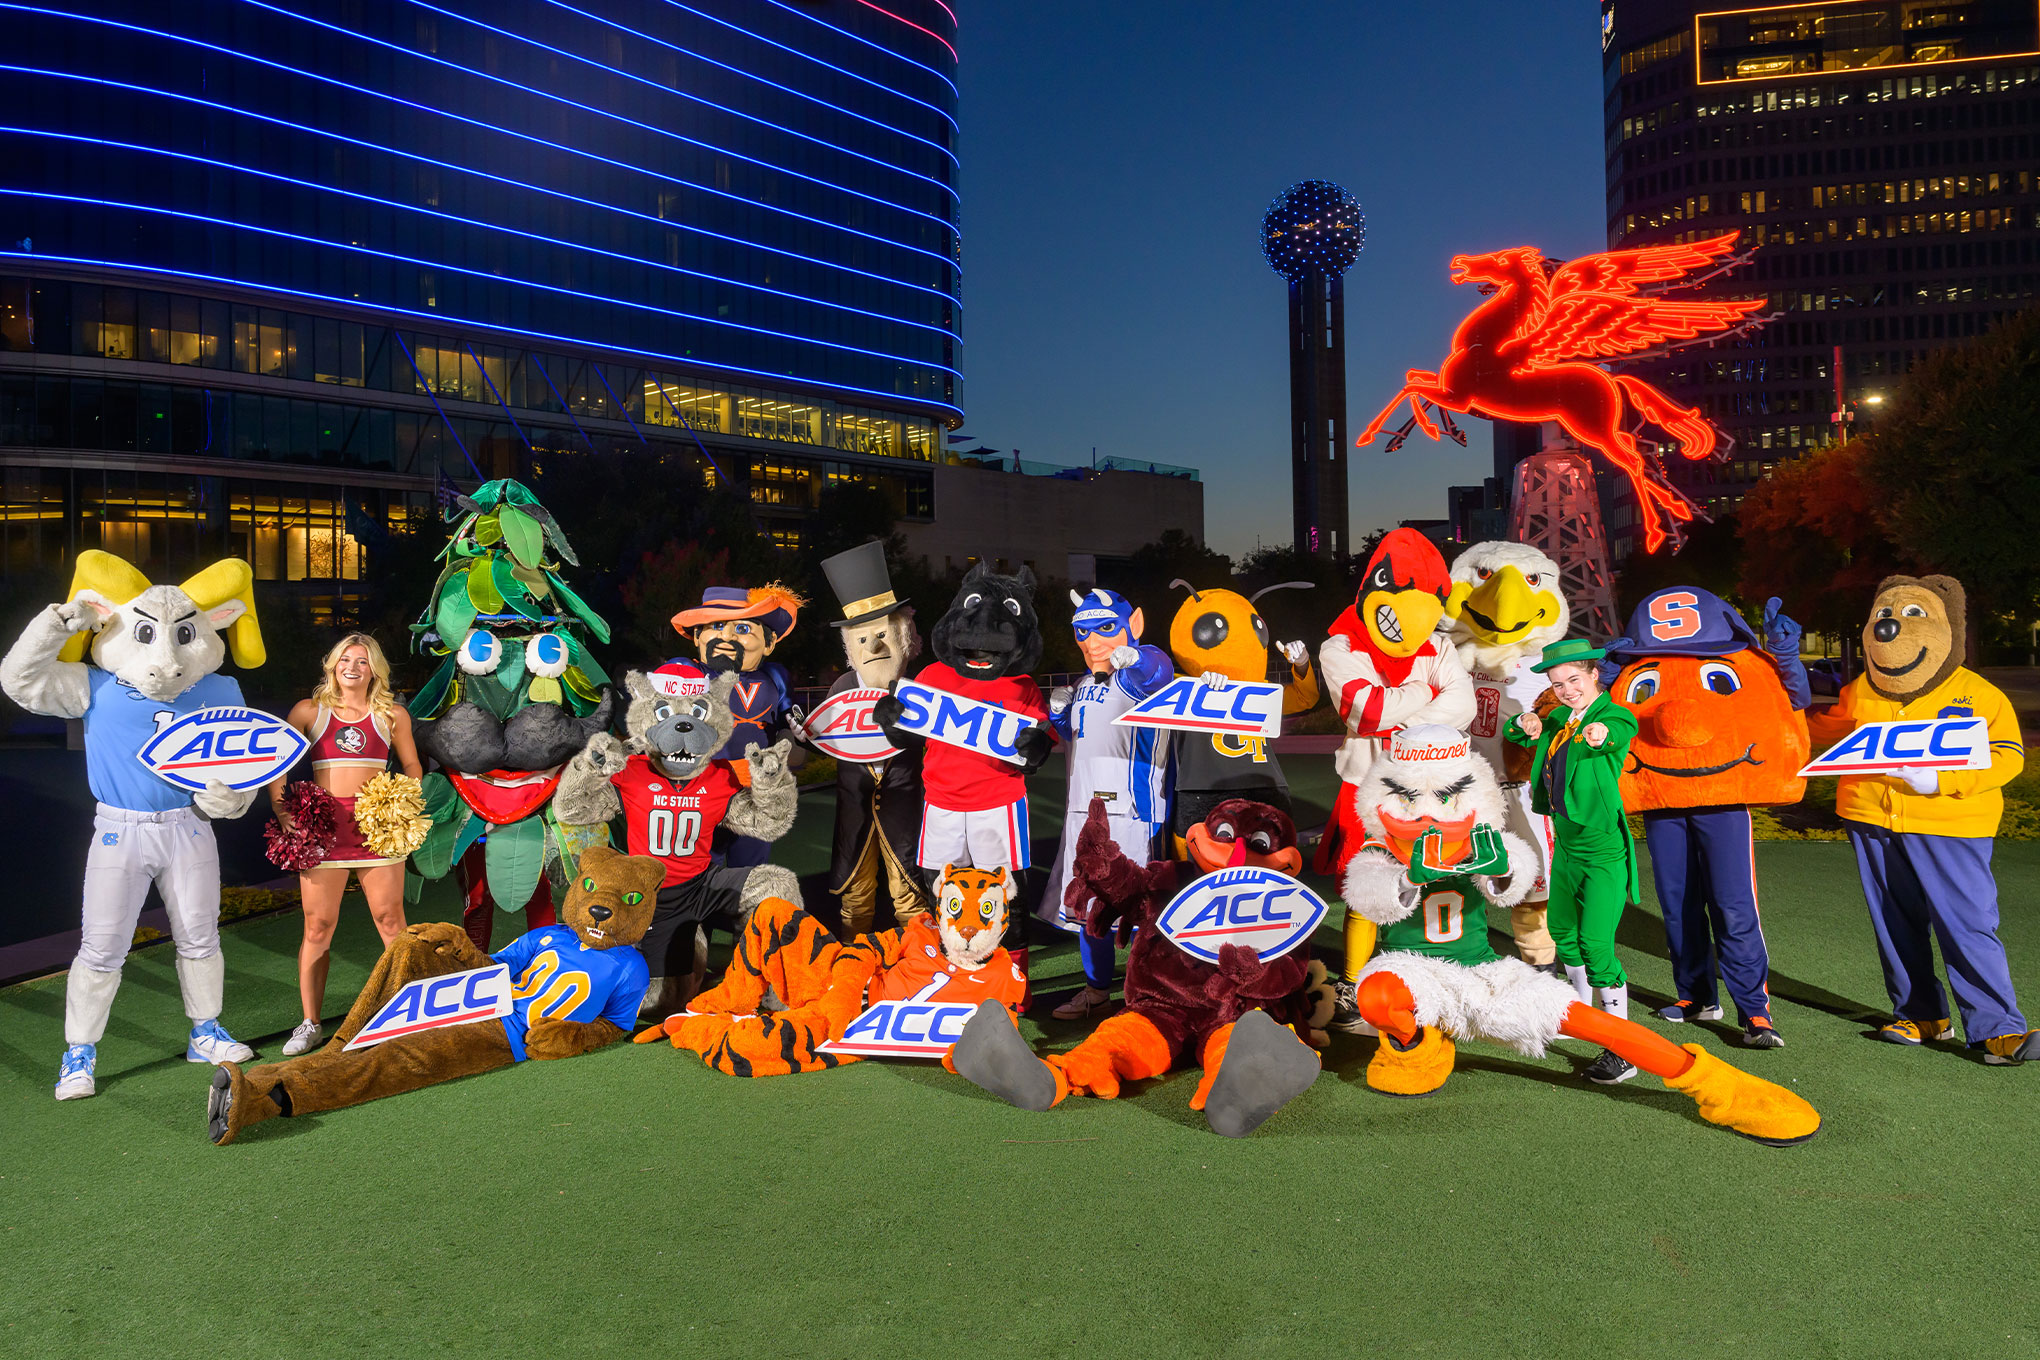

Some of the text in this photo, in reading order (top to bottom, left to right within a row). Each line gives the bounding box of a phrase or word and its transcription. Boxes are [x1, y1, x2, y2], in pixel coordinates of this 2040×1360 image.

[1649, 592, 1701, 641] S
[664, 681, 705, 696] NC STATE
[734, 681, 762, 712] V
[1135, 681, 1280, 722] ACC
[822, 708, 880, 733] AC
[897, 686, 1032, 757] SMU
[1078, 705, 1085, 738] 1
[167, 726, 282, 761] ACC
[1394, 741, 1467, 761] Hurricanes
[1819, 721, 1982, 762] ACC
[653, 795, 700, 808] NC STATE
[648, 809, 702, 857] 00
[1183, 888, 1298, 929] ACC
[1423, 890, 1464, 943] 0
[366, 968, 505, 1031] ACC
[844, 1005, 973, 1043] ACC
